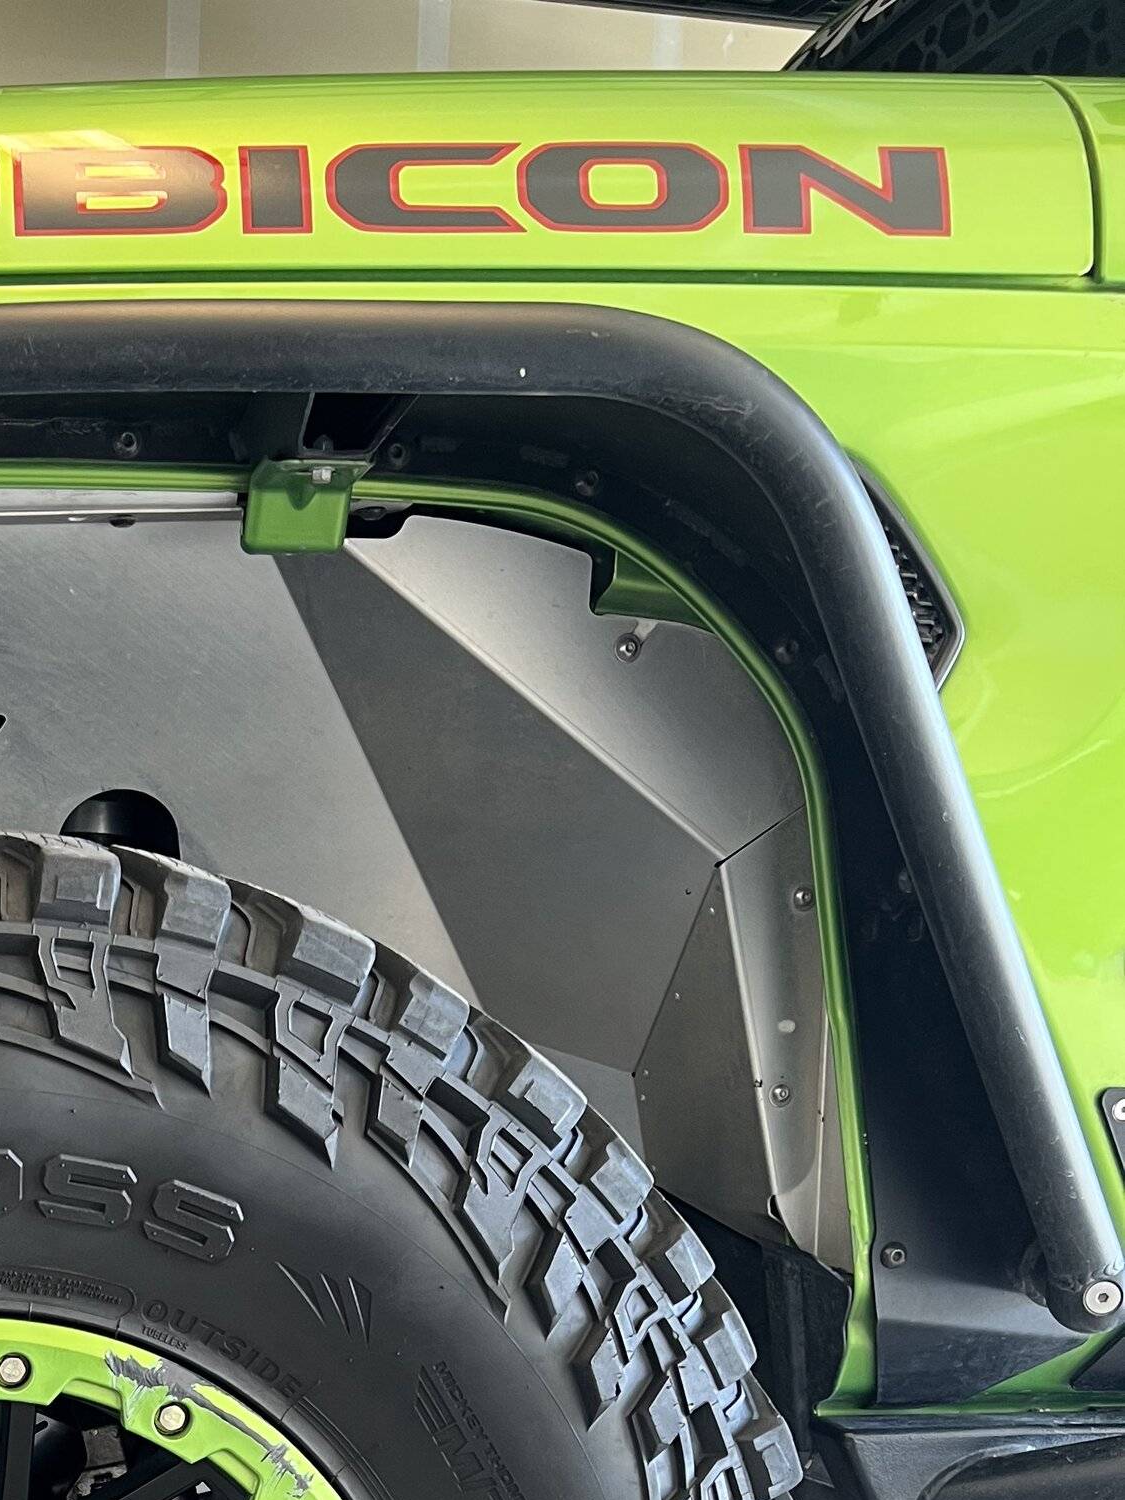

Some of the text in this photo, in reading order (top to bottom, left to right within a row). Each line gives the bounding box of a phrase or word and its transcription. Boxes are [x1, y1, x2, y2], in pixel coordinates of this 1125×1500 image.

[140, 1300, 304, 1399] OUTSIDE
[141, 1325, 189, 1353] TUBELESS
[431, 1359, 491, 1443] MICKEY
